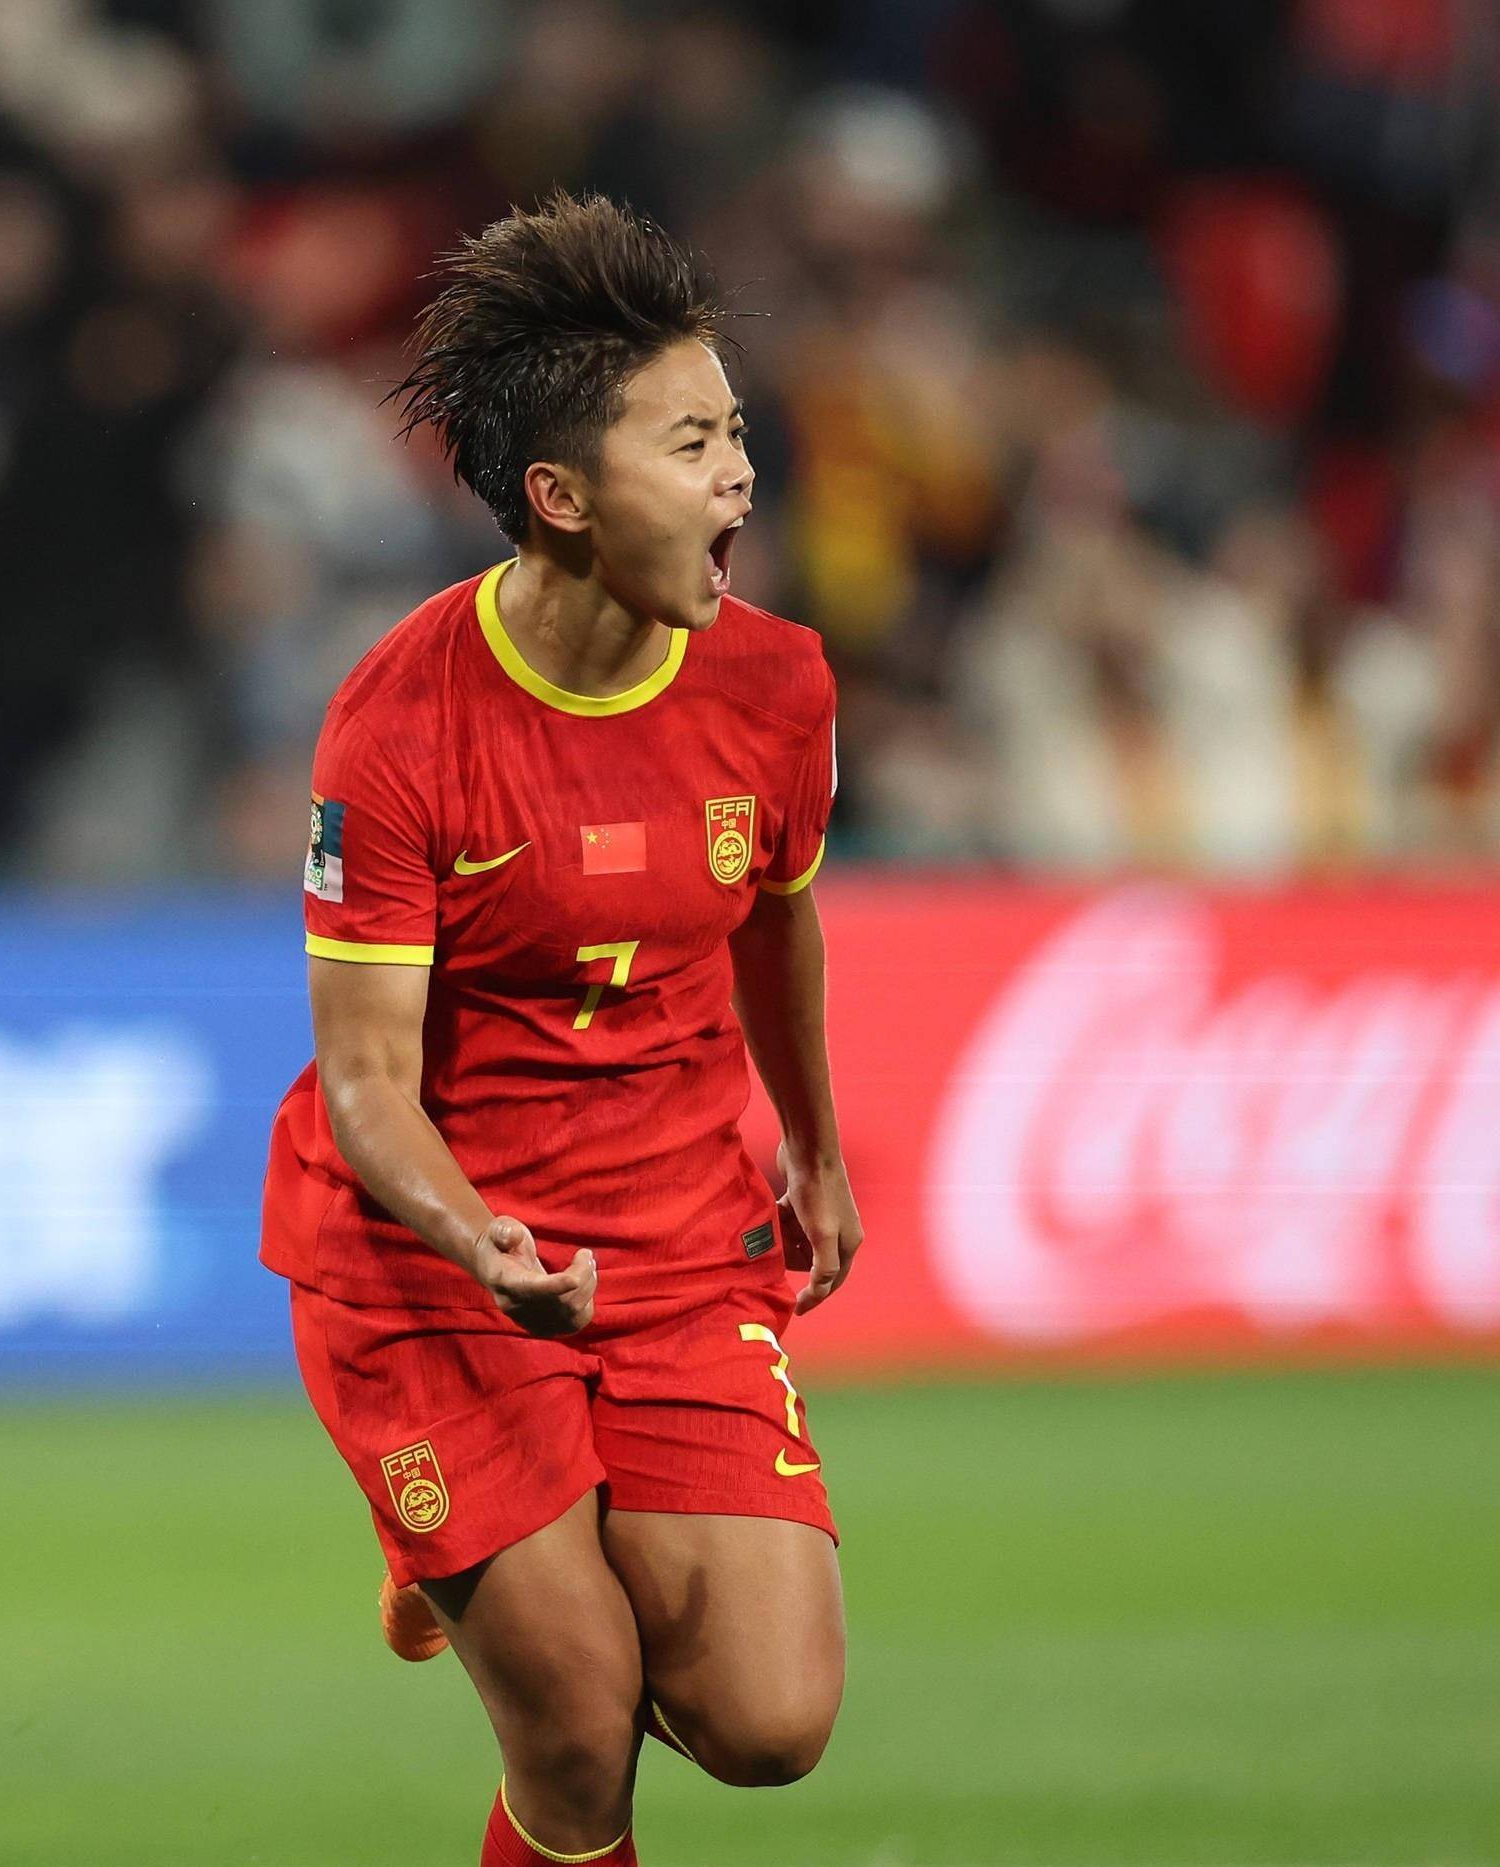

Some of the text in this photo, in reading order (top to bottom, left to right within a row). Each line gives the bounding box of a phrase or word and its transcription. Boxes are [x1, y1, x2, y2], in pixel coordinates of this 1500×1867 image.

[710, 801, 750, 821] CFA
[572, 940, 640, 1030] 7
[738, 1323, 800, 1439] 7
[386, 1447, 431, 1477] CFA
[402, 1467, 421, 1480] 中国
